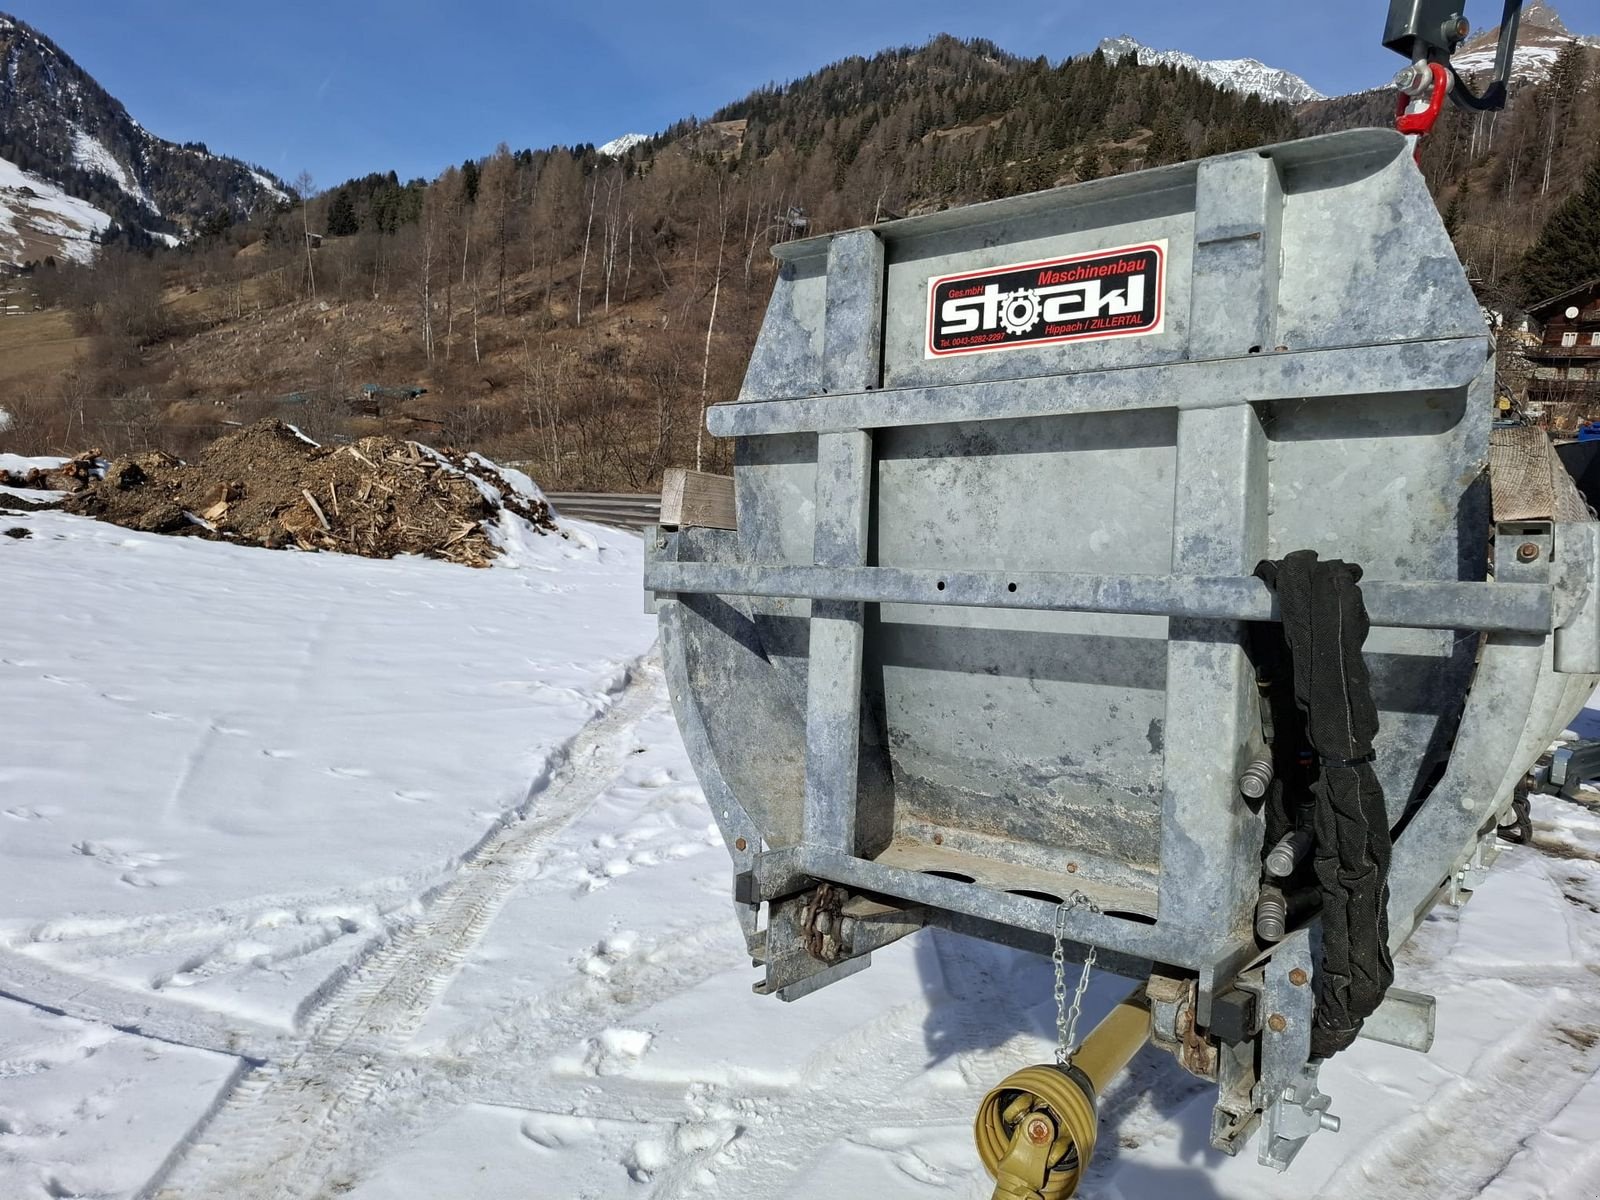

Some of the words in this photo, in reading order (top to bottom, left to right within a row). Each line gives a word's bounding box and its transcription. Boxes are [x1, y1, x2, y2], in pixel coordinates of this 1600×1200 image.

[1038, 259, 1146, 285] Maschinenbau
[1045, 321, 1083, 335] Hippach
[1084, 321, 1089, 330] /
[1090, 314, 1143, 329] ZILLERTAL
